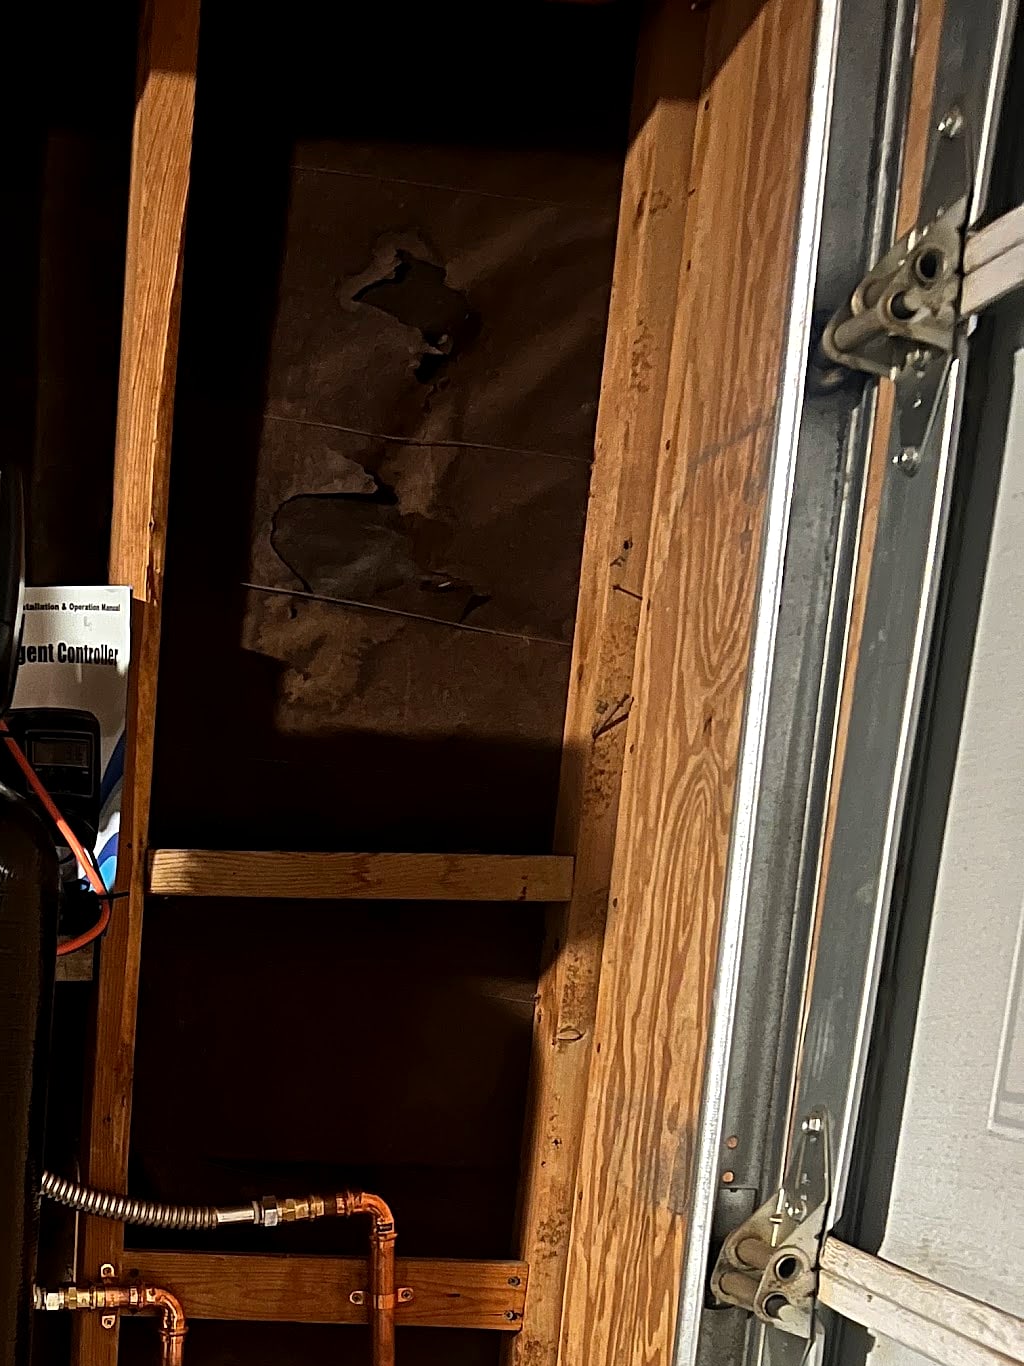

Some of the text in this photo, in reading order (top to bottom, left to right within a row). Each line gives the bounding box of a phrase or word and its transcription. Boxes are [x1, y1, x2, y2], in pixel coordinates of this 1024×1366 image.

[23, 603, 121, 613] tallation & Operation Manual
[18, 642, 119, 666] gent Controller
